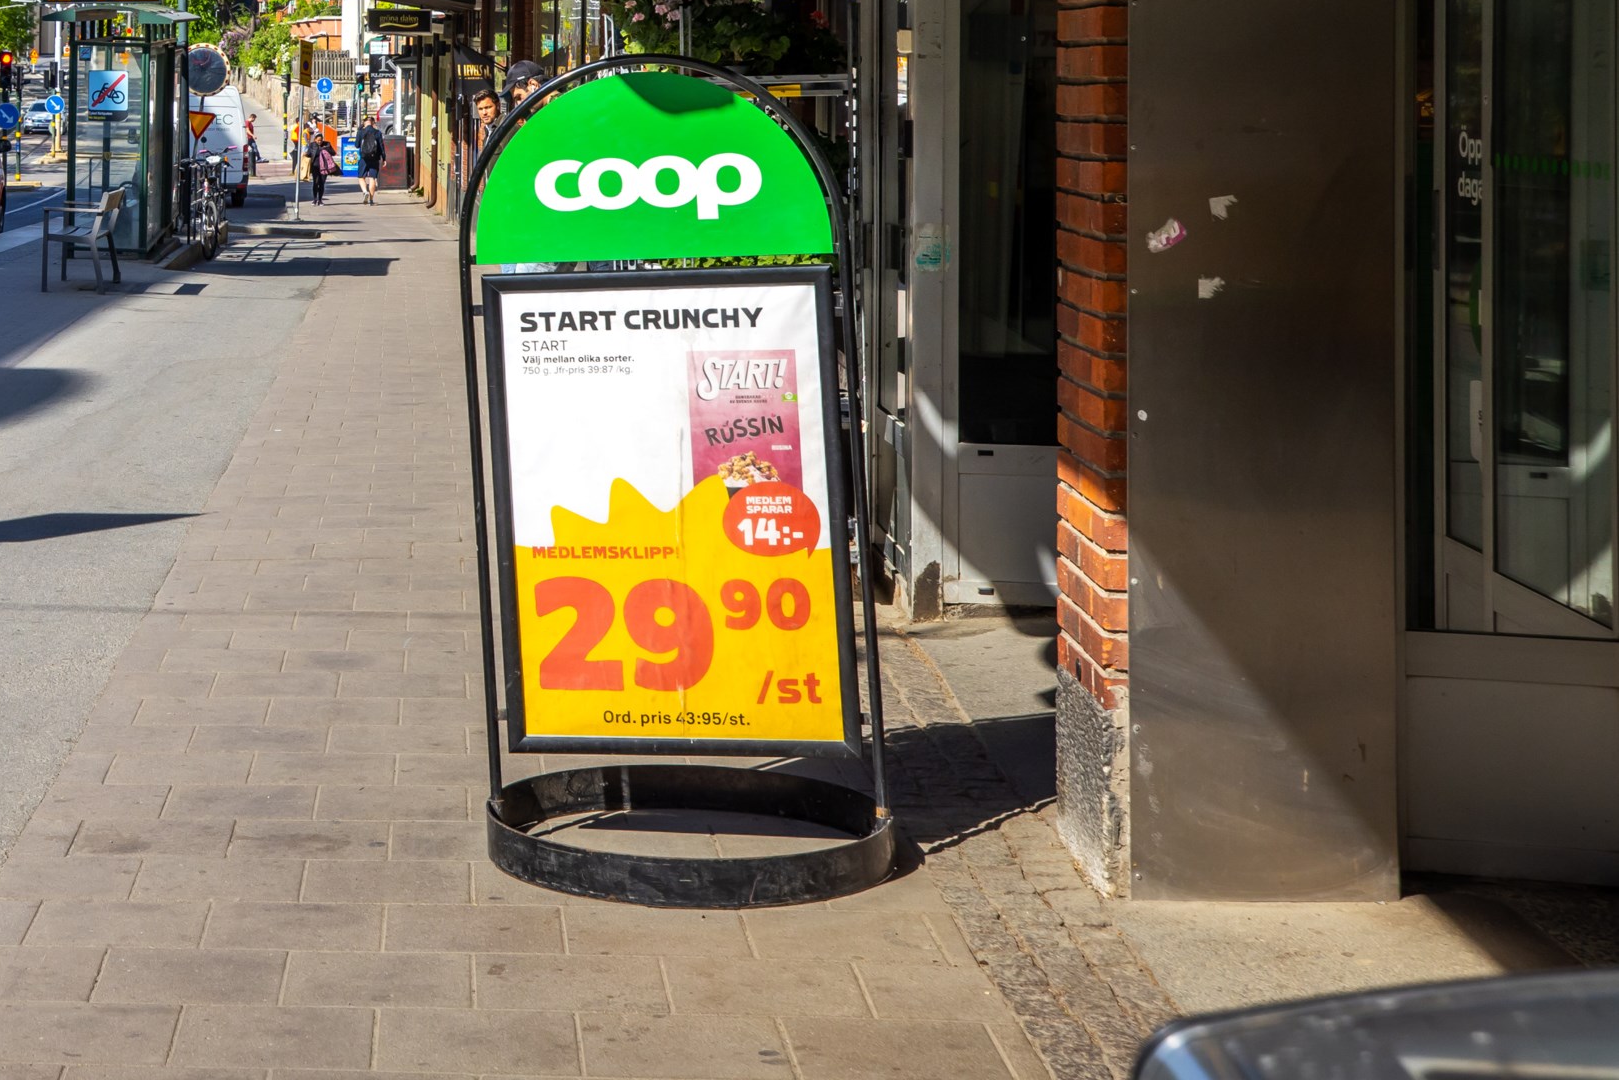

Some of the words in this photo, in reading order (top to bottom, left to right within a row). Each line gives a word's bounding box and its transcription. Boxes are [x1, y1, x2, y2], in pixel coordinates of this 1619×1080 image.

[212, 114, 234, 125] EC
[534, 152, 763, 220] coop
[520, 310, 617, 333] START
[623, 306, 764, 331] CRUNCHY
[521, 339, 568, 352] START
[522, 355, 541, 365] Välj
[543, 354, 575, 364] mellan
[578, 354, 601, 363] olika
[603, 354, 635, 363] sorter.
[522, 366, 540, 375] 750
[543, 367, 552, 376] g.
[553, 365, 586, 376] Jfr-pris
[587, 365, 614, 374] 39:87
[696, 357, 788, 401] START!
[704, 414, 784, 447] RUSSIN
[746, 496, 792, 505] MEDLEM
[746, 505, 793, 514] SPARAR
[737, 518, 804, 546] 14:-
[534, 575, 715, 692] 29
[719, 577, 812, 632] 90
[756, 669, 823, 705] /st
[603, 710, 637, 725] Ord.
[640, 711, 671, 727] pris
[675, 711, 751, 727] 43:95/st.
